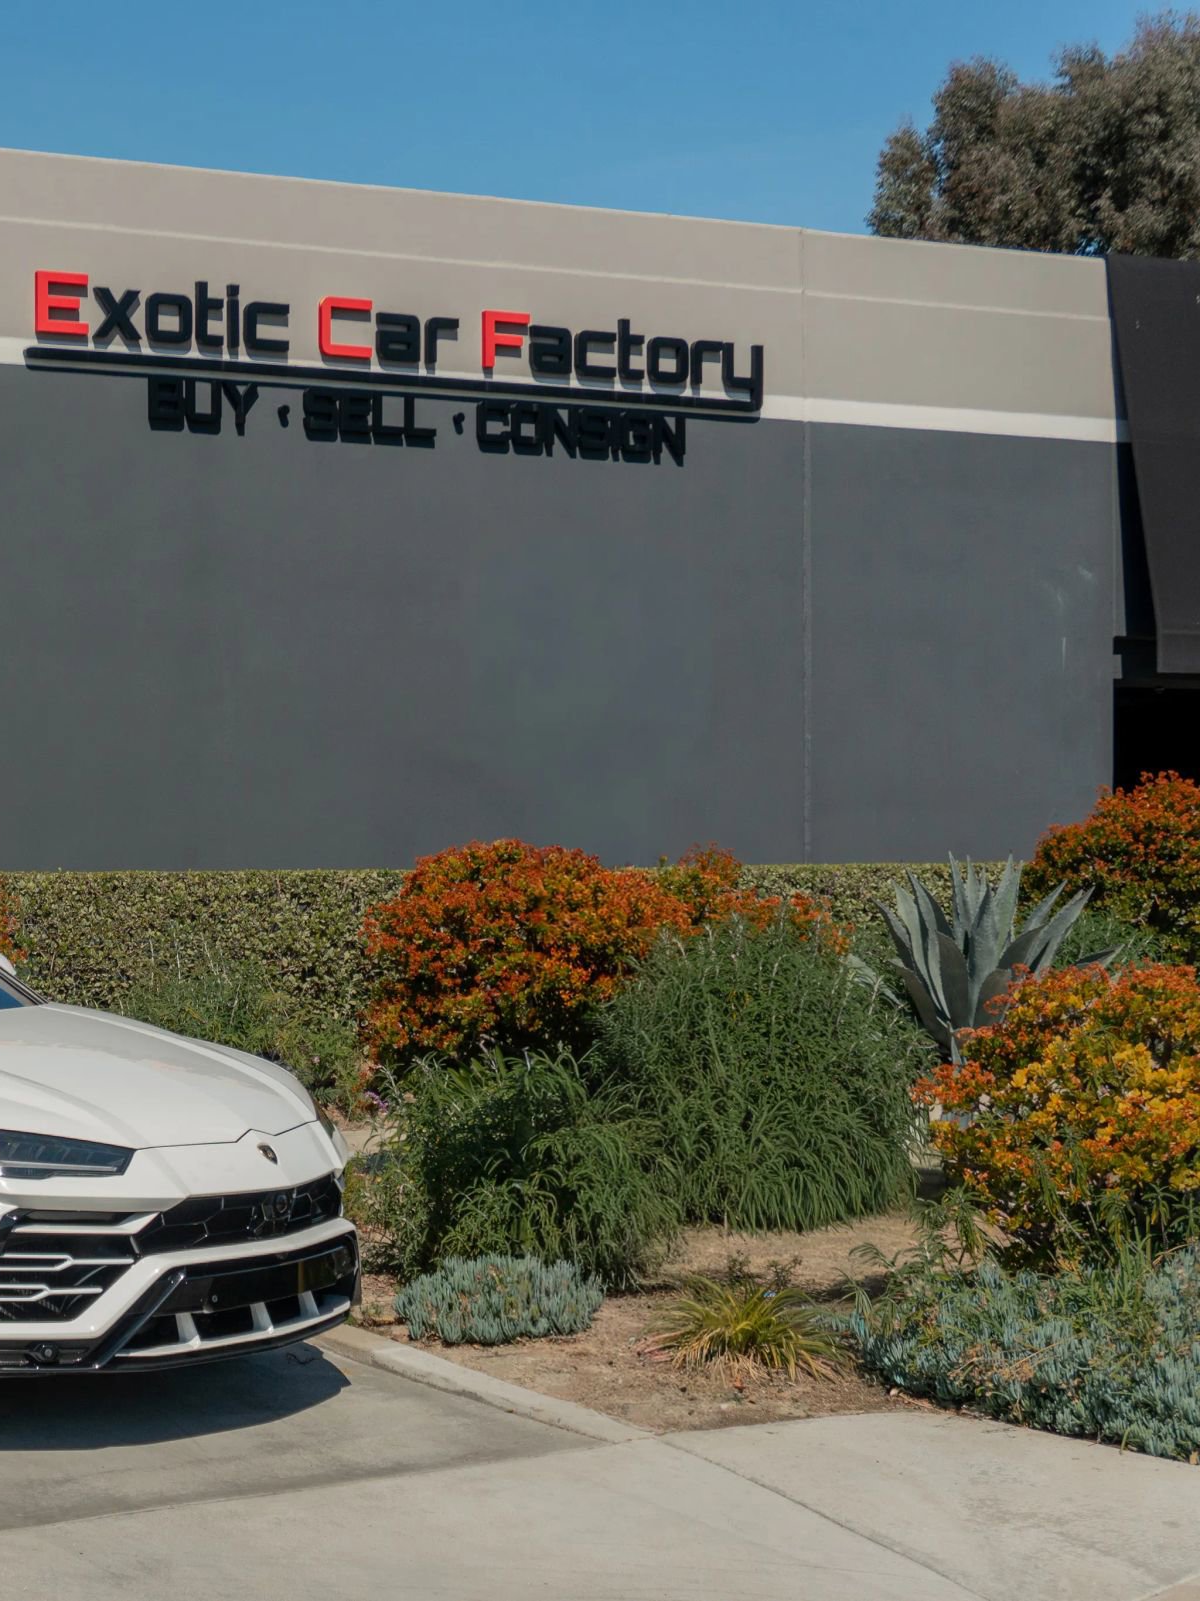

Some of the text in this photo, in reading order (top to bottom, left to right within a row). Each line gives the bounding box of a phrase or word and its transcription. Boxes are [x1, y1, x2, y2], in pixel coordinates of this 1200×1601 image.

[35, 271, 764, 412] Exotic Car Factory
[148, 376, 686, 464] BUY SELL CONSIGN
